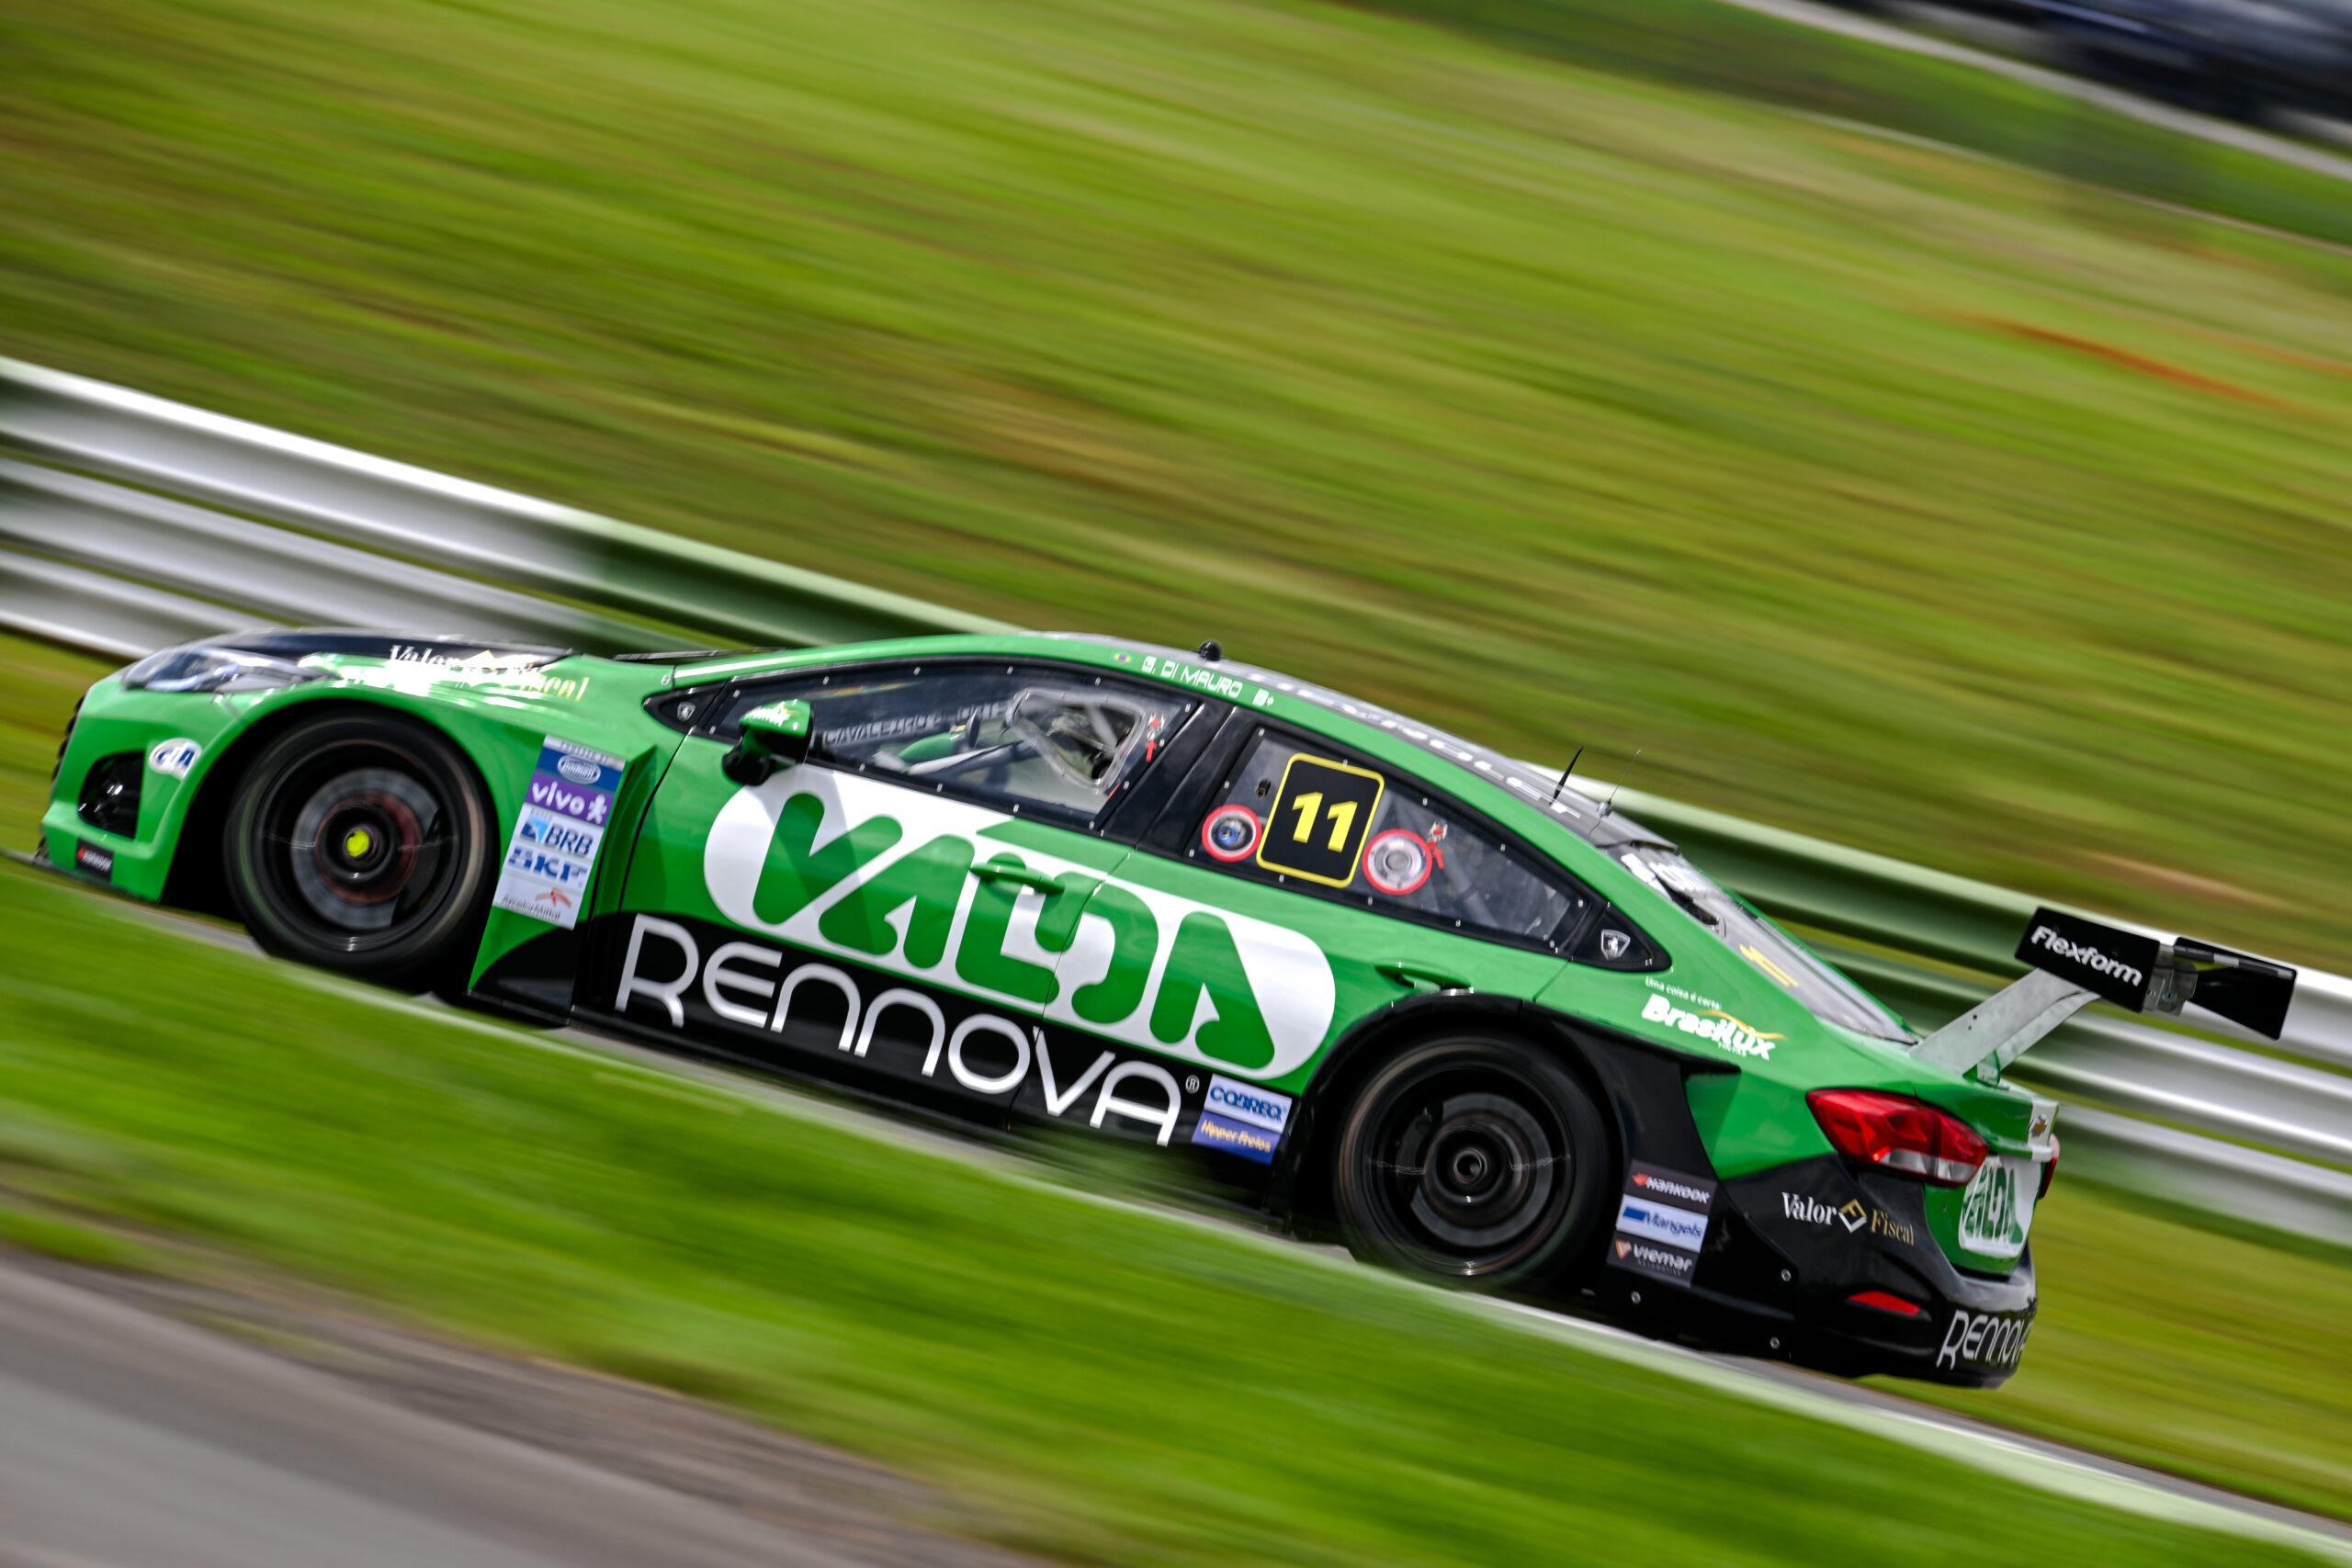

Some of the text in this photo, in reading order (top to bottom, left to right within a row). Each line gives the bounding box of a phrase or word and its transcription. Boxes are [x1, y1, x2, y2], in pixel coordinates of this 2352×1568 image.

[1159, 661, 1179, 680] DI
[1181, 666, 1243, 699] MAURO
[531, 781, 585, 816] vivo
[544, 822, 594, 859] BRB
[1292, 792, 1357, 852] 11
[752, 791, 1275, 1070] VALDA
[2030, 925, 2143, 987] Flexform
[1645, 976, 1665, 992] Uma
[615, 912, 1182, 1146] RENNOVA
[1641, 993, 1776, 1061] Brasilux
[1209, 1086, 1283, 1122] COBREQ
[1781, 1191, 1838, 1225] Valor
[1870, 1209, 1915, 1247] Fiscal
